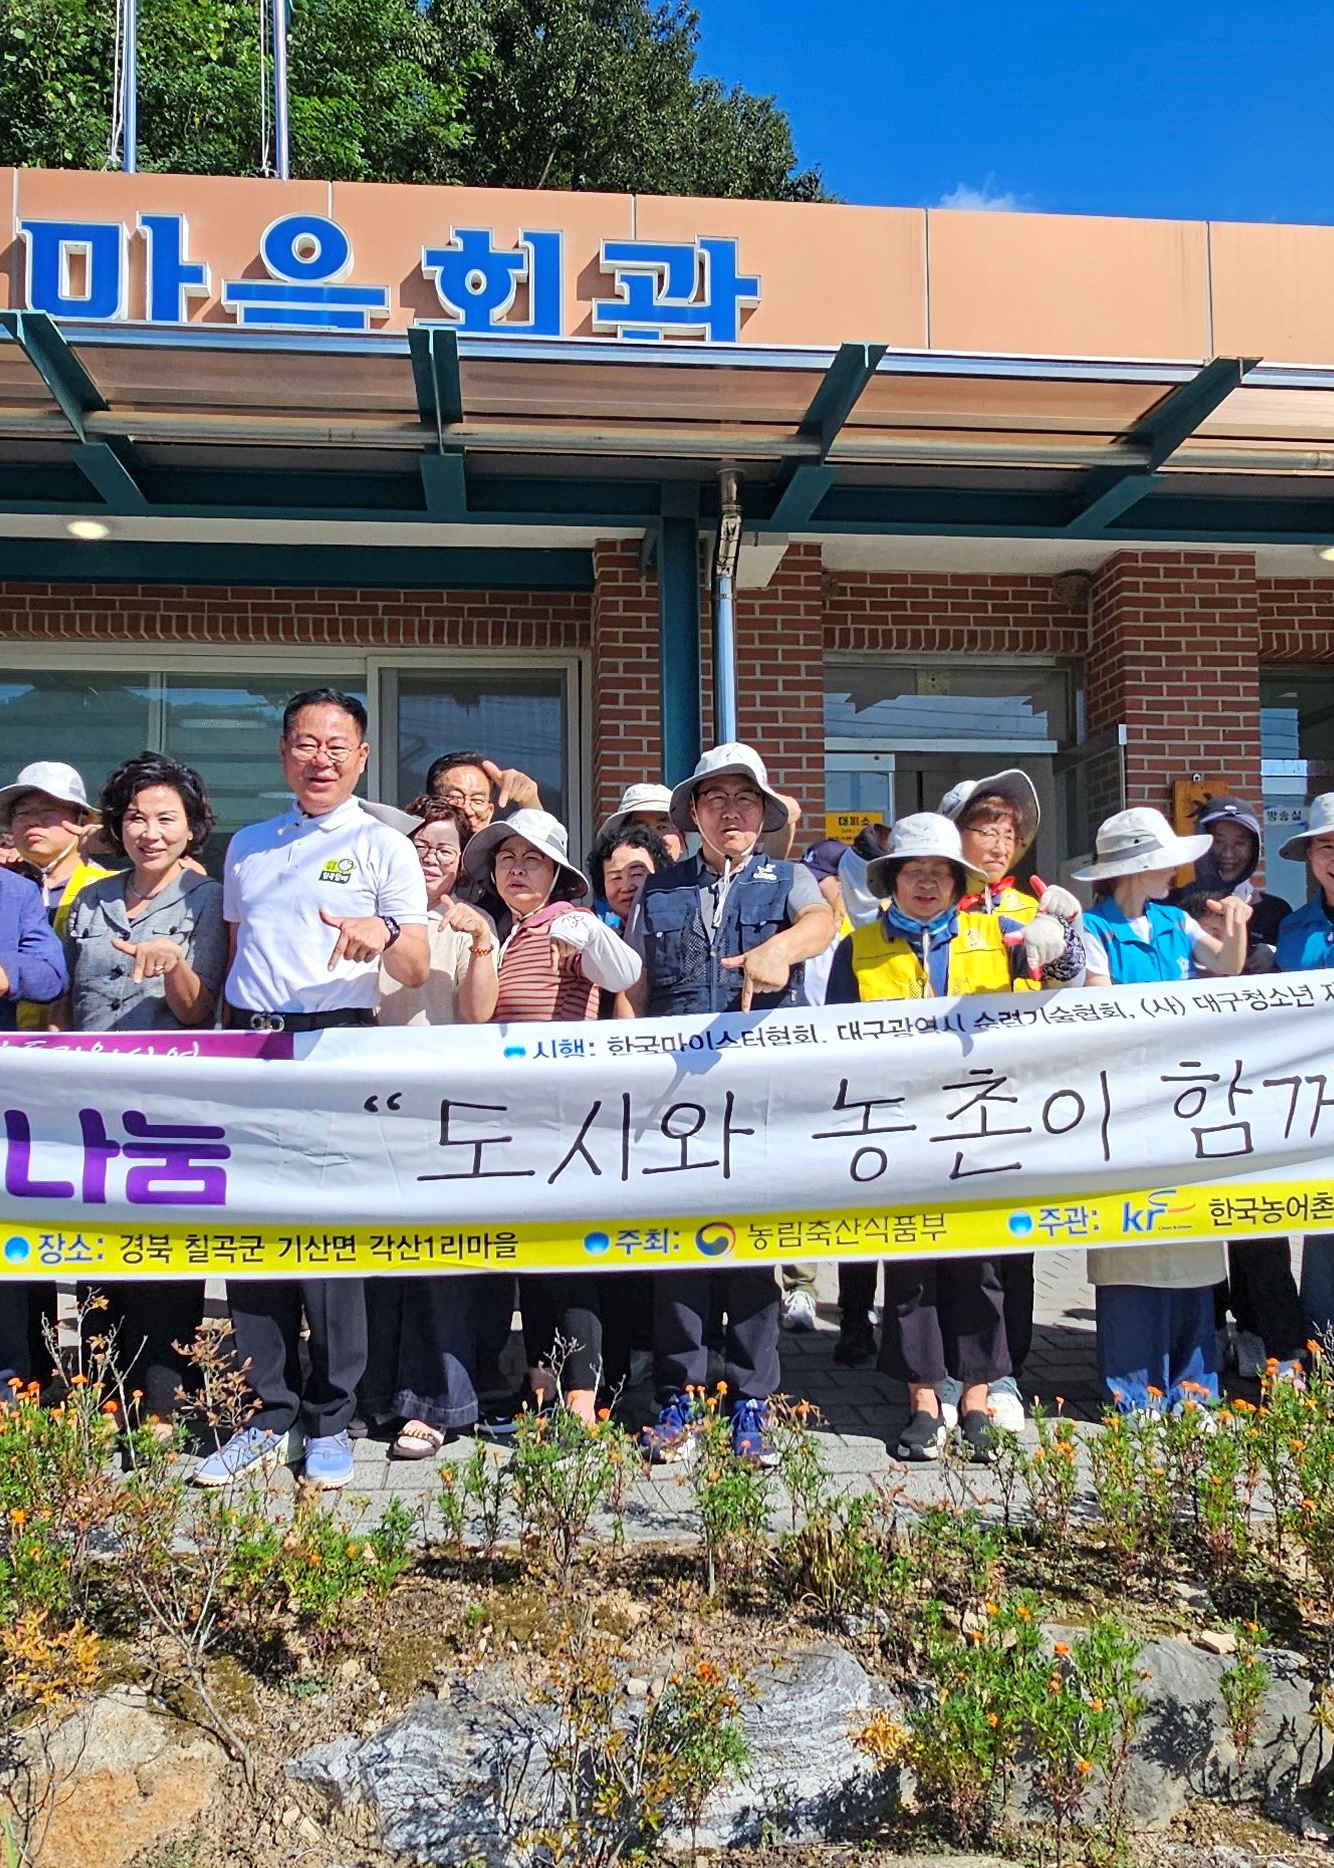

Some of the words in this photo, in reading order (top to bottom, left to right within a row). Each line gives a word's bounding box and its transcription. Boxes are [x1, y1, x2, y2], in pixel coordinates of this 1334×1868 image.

[16, 211, 762, 343] 마을회관
[533, 1038, 596, 1059] 시행:
[837, 1012, 966, 1041] 대구광역시
[1140, 995, 1187, 1018] (사)
[1192, 985, 1315, 1013] 대구청소년
[812, 1068, 1111, 1184] 농촌이
[37, 1232, 106, 1266] 장소:
[120, 1233, 172, 1265] 경북
[185, 1233, 266, 1264] 칠곡군
[278, 1233, 356, 1264] 기산면
[370, 1231, 519, 1262] 각산1리마을
[615, 1226, 681, 1257] 주최:
[747, 1212, 948, 1251] 농림축산식품부
[1037, 1206, 1100, 1238] 주관:
